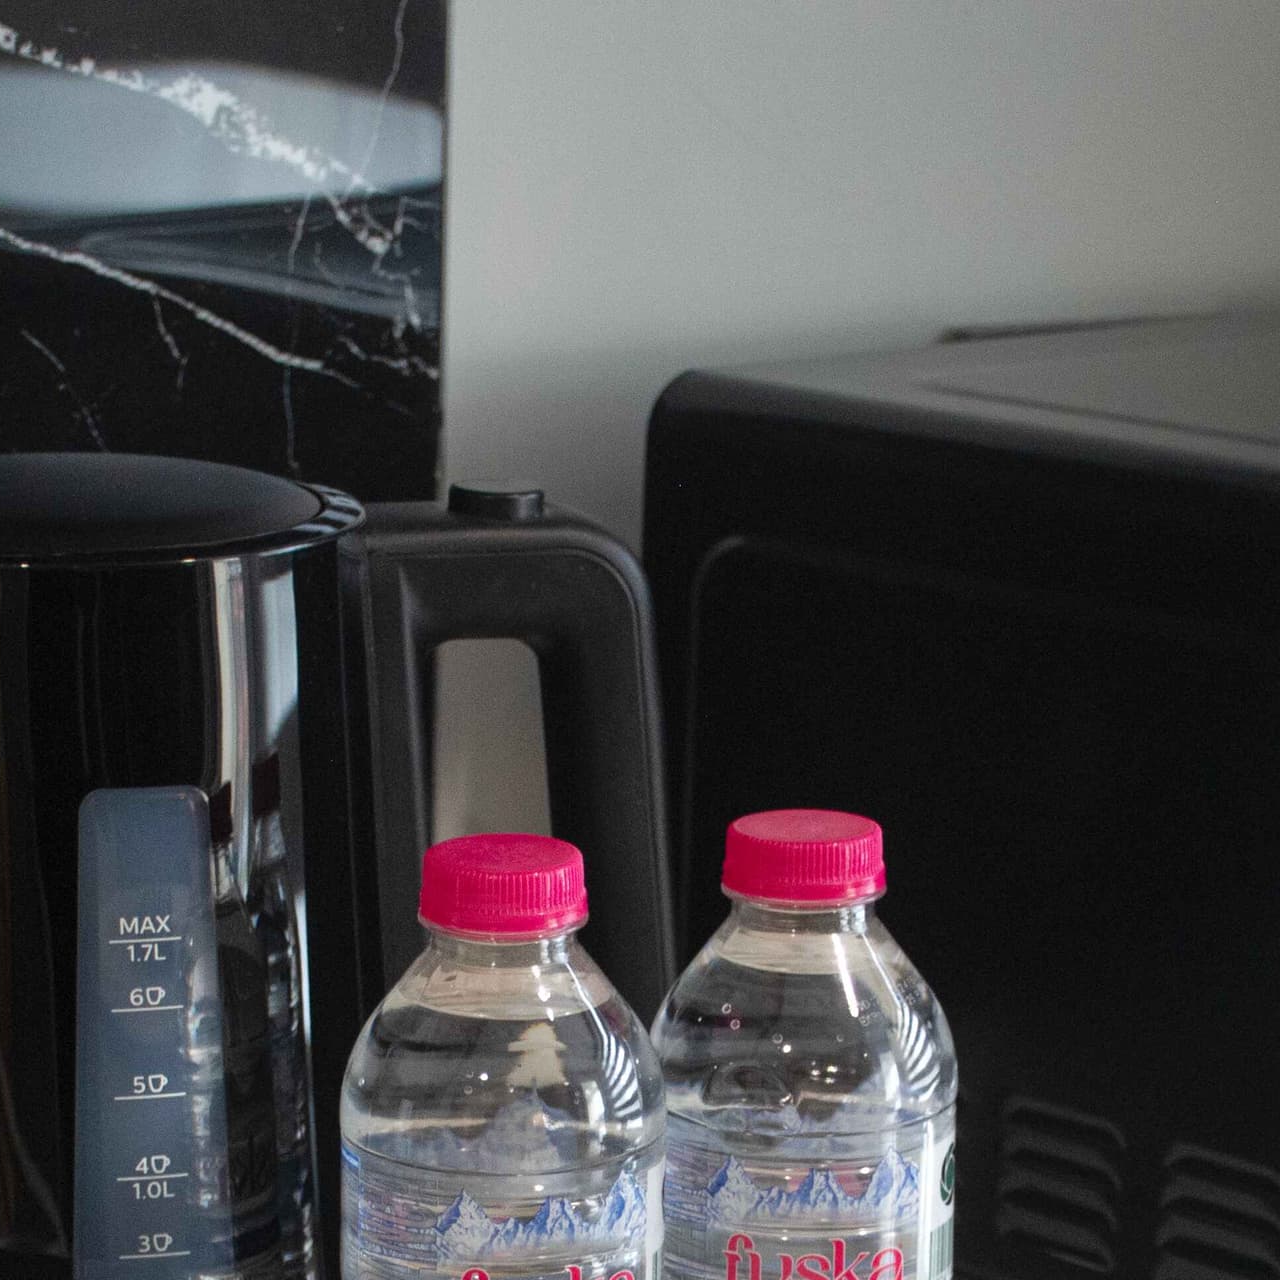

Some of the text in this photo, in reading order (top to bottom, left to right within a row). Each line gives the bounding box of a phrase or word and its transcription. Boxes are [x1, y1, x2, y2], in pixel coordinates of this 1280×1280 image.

[119, 914, 171, 936] MAX
[127, 943, 167, 963] 1.7L
[129, 987, 144, 1007] 6
[132, 1075, 147, 1095] 5
[134, 1156, 149, 1175] 4
[131, 1181, 176, 1201] 1.0L
[137, 1234, 152, 1254] 3
